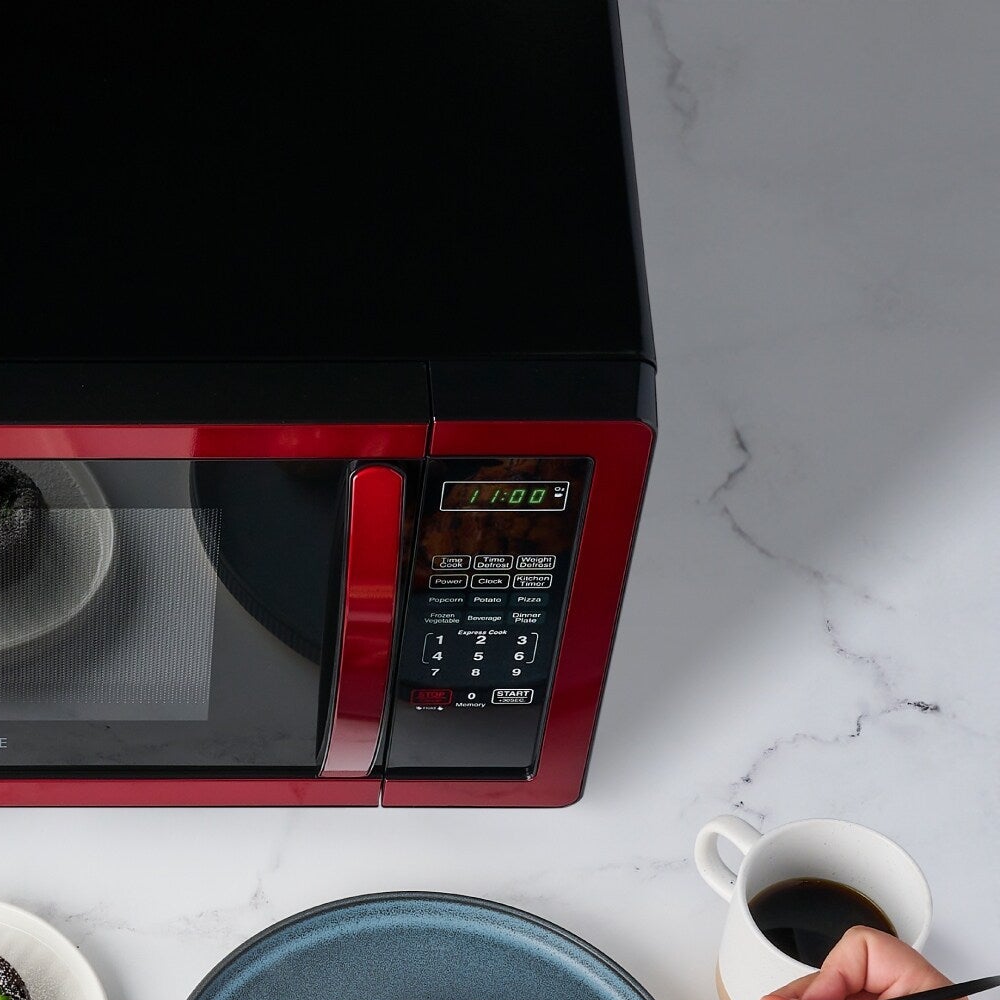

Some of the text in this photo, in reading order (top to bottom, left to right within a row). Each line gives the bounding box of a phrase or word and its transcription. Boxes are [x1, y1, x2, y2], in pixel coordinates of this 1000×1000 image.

[470, 489, 546, 503] 11:00
[435, 635, 444, 645] 1
[475, 635, 487, 645] 2
[516, 635, 528, 645] 3
[431, 651, 443, 661] 4
[473, 651, 484, 661] 5
[514, 651, 525, 661] 6
[430, 668, 441, 677] 7
[471, 668, 481, 677] 8
[511, 668, 522, 677] 9
[467, 692, 476, 700] 0
